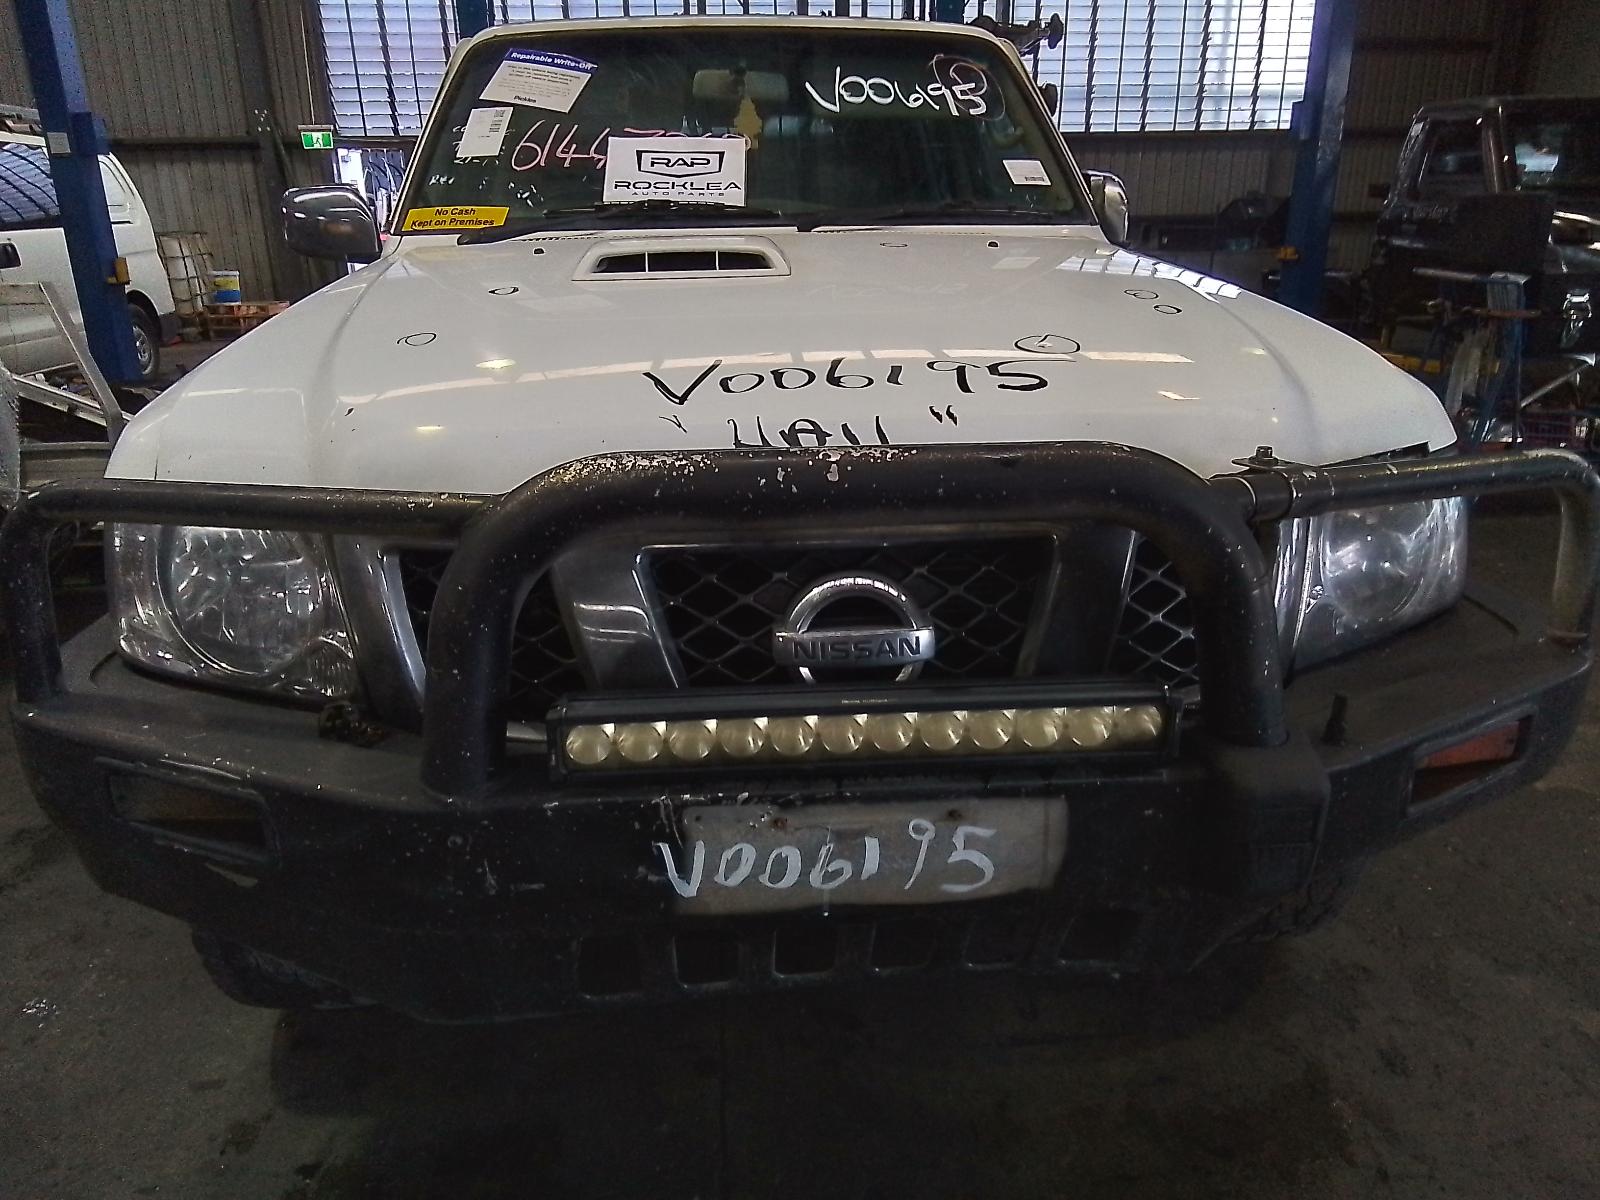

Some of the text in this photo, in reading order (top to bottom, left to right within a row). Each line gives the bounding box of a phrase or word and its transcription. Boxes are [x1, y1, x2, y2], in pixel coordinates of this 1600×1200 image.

[511, 52, 553, 63] Repairable
[805, 66, 987, 116] V006195
[650, 157, 711, 168] RAP
[614, 180, 742, 191] ROCKLEA
[434, 207, 476, 216] No Cash
[411, 219, 432, 228] Kept
[448, 217, 495, 226] Premises
[642, 359, 1075, 406] V006195
[793, 635, 921, 661] NISSAN
[652, 818, 997, 898] V006195
